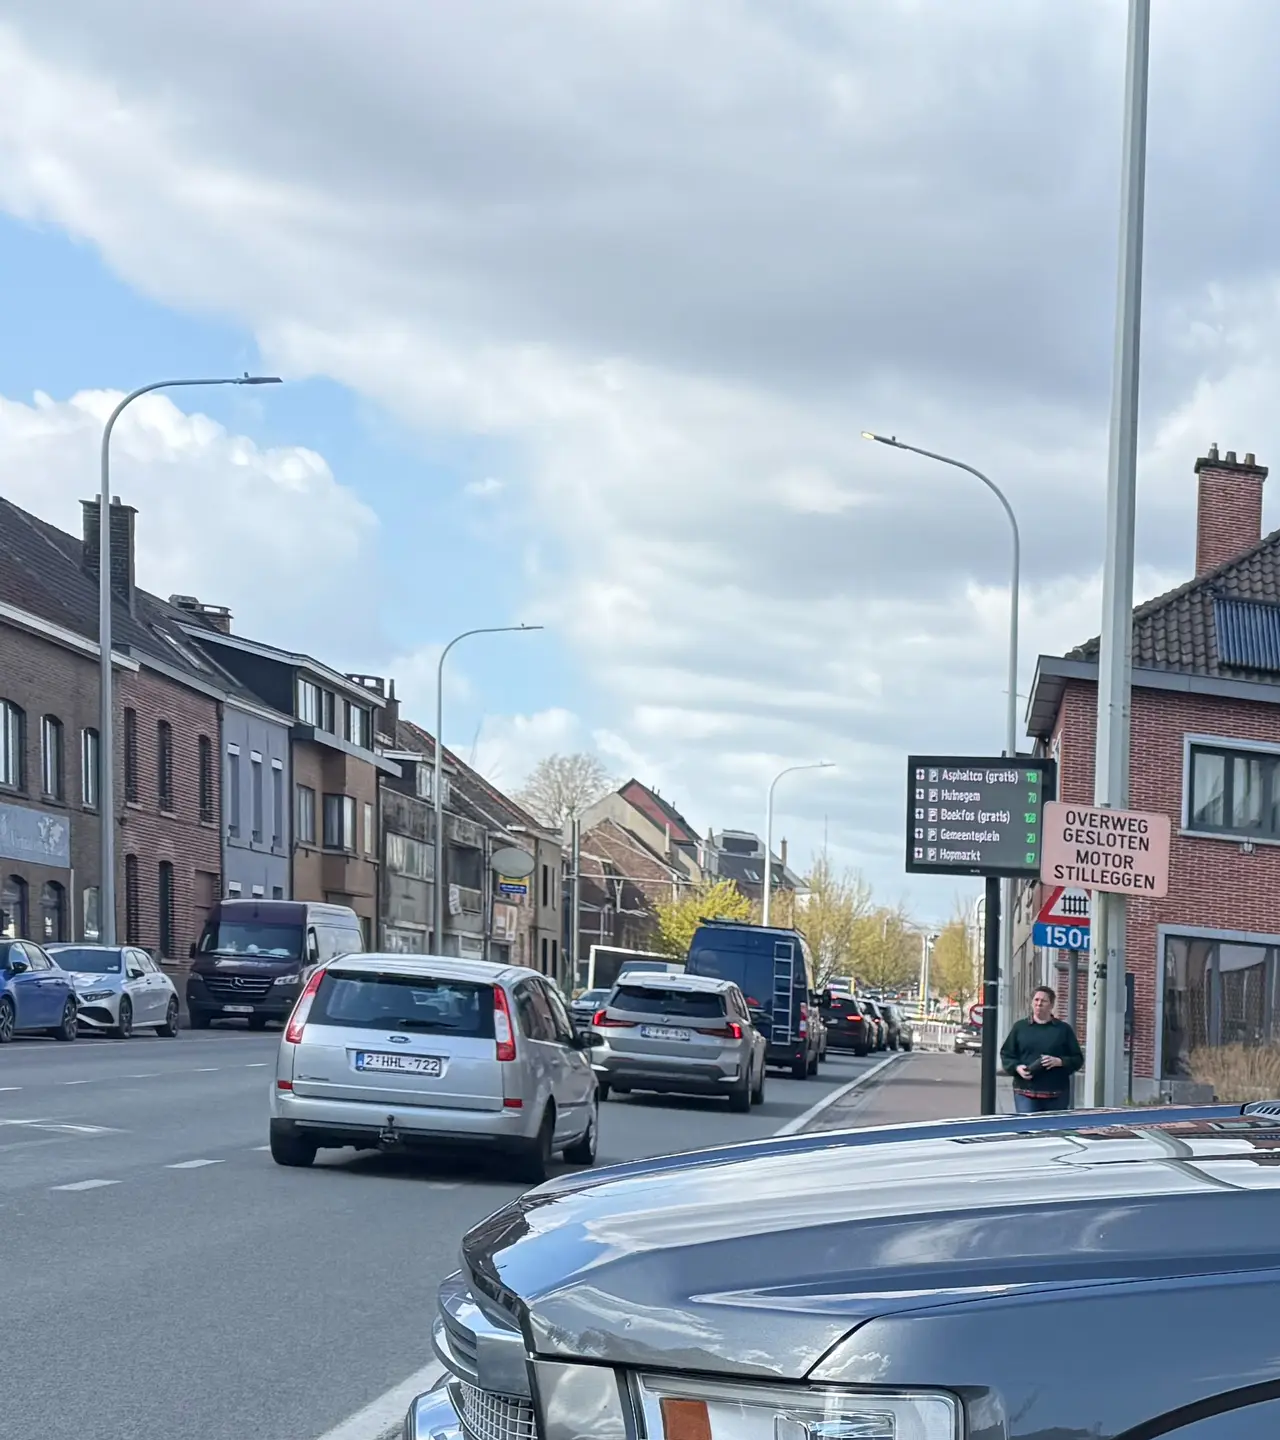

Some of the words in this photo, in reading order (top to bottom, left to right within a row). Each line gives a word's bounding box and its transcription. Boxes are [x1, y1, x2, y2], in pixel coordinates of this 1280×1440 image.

[985, 770, 1019, 784] (gratis)
[978, 809, 1010, 824] (gratis)
[1065, 810, 1148, 834] OVERWEG
[940, 828, 1000, 843] Gemeenteplein
[1063, 827, 1150, 851] GESLOTEN
[939, 848, 981, 862] Hopmarkt
[1075, 849, 1134, 870] MOTOR
[1054, 864, 1155, 890] STILLEGGEN
